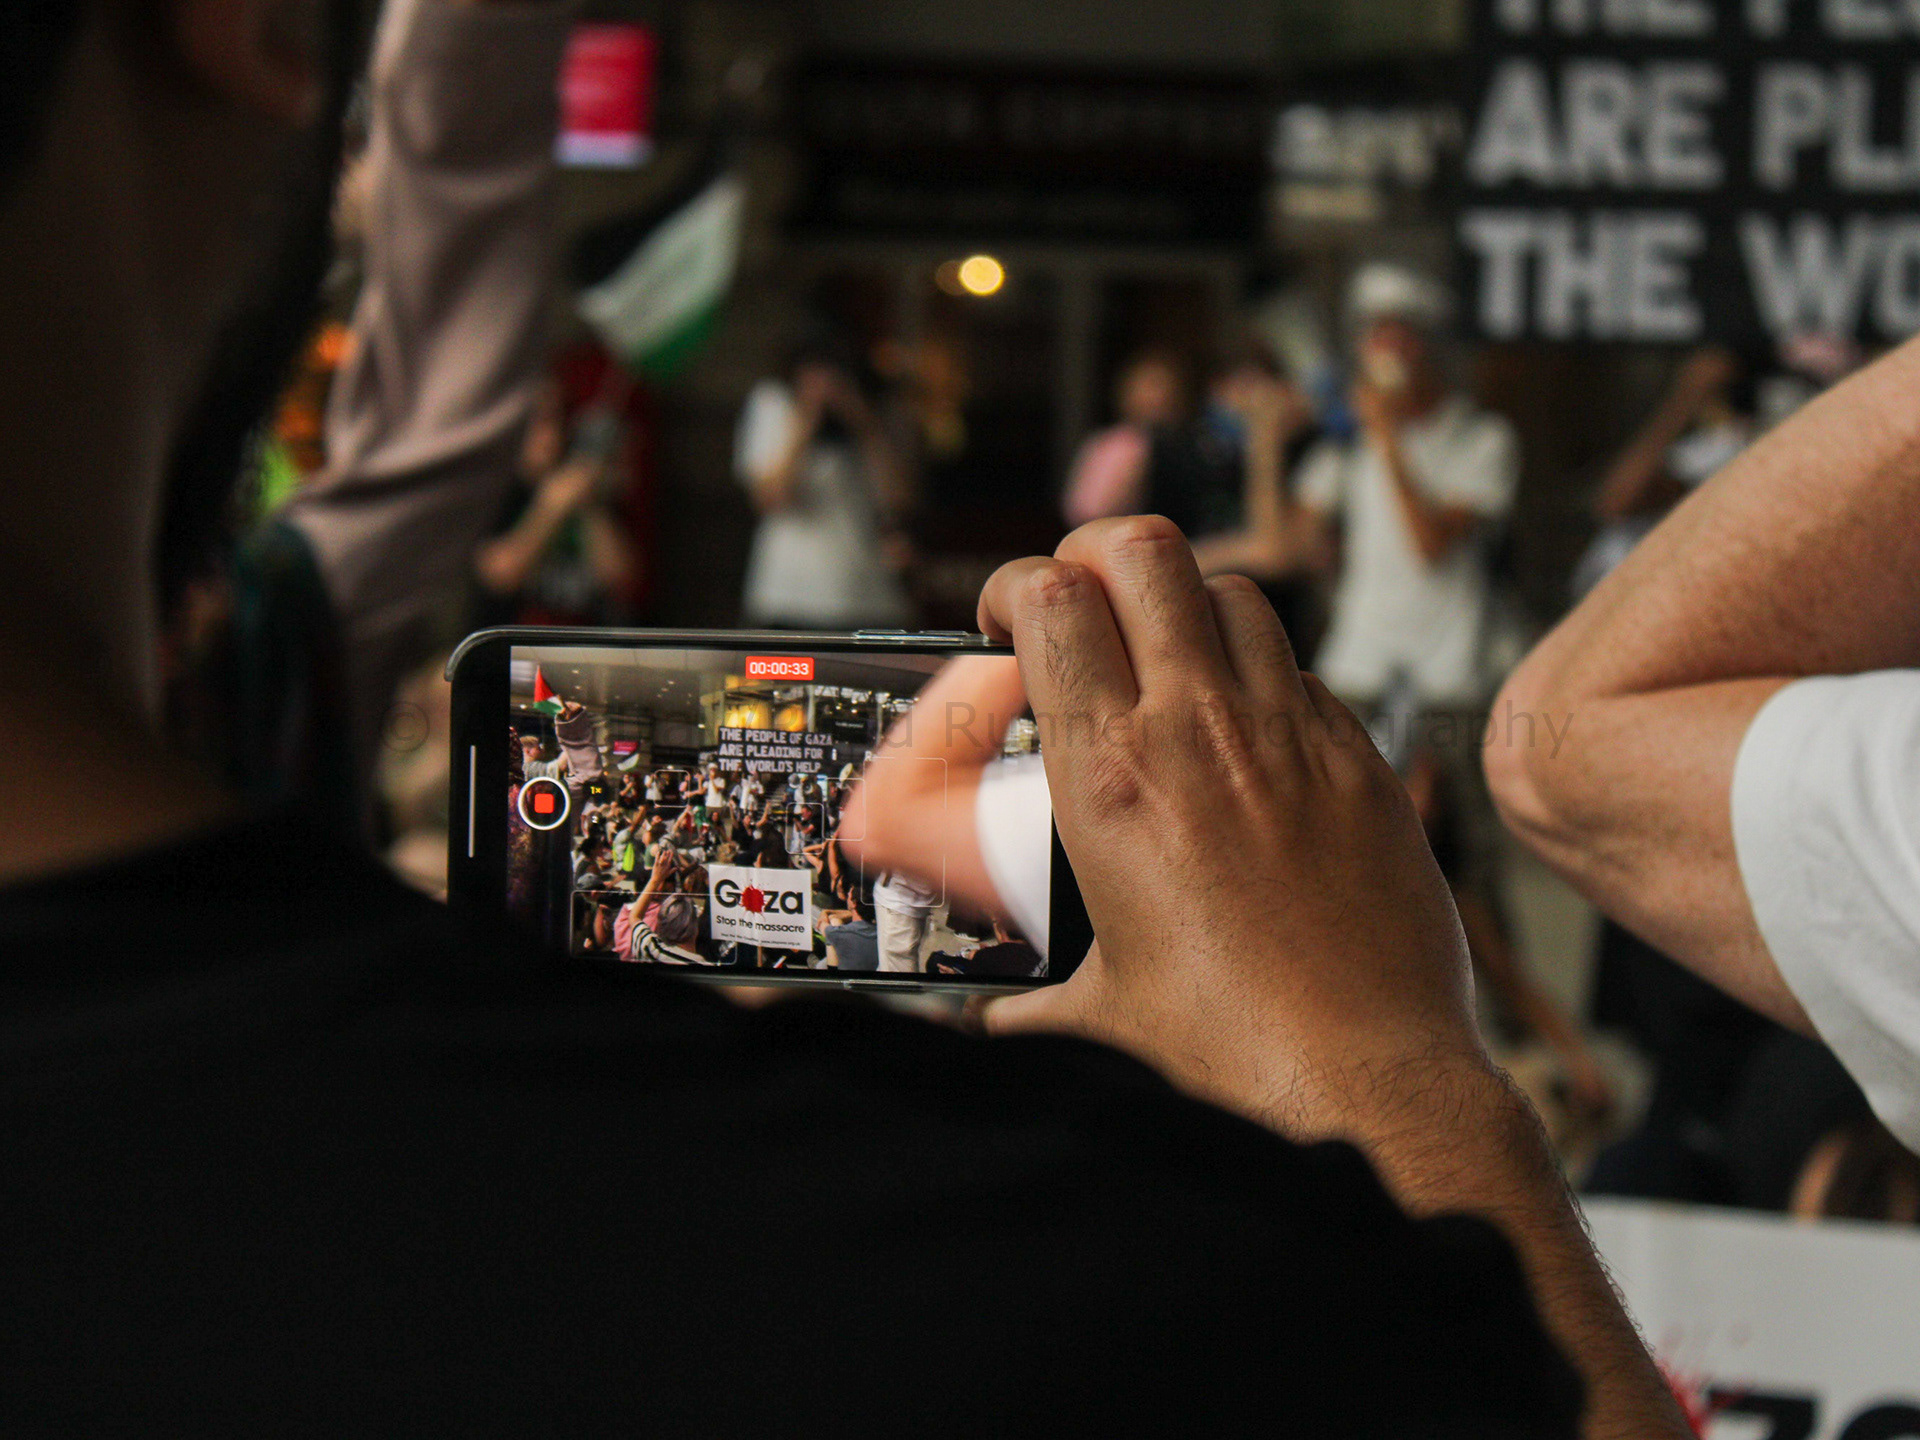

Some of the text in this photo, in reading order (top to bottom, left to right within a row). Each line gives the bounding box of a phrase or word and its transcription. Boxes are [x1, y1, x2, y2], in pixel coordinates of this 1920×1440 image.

[1468, 58, 1726, 188] ARE
[1460, 208, 1704, 340] THE
[749, 661, 809, 675] 00:00:33
[720, 727, 833, 746] THE PEOPLE OF GAZA
[719, 743, 824, 760] ARE PLEADING FOR
[719, 758, 822, 773] THE WORLD'S HELP
[591, 815, 599, 824] 2
[716, 915, 805, 933] Stop the massacre
